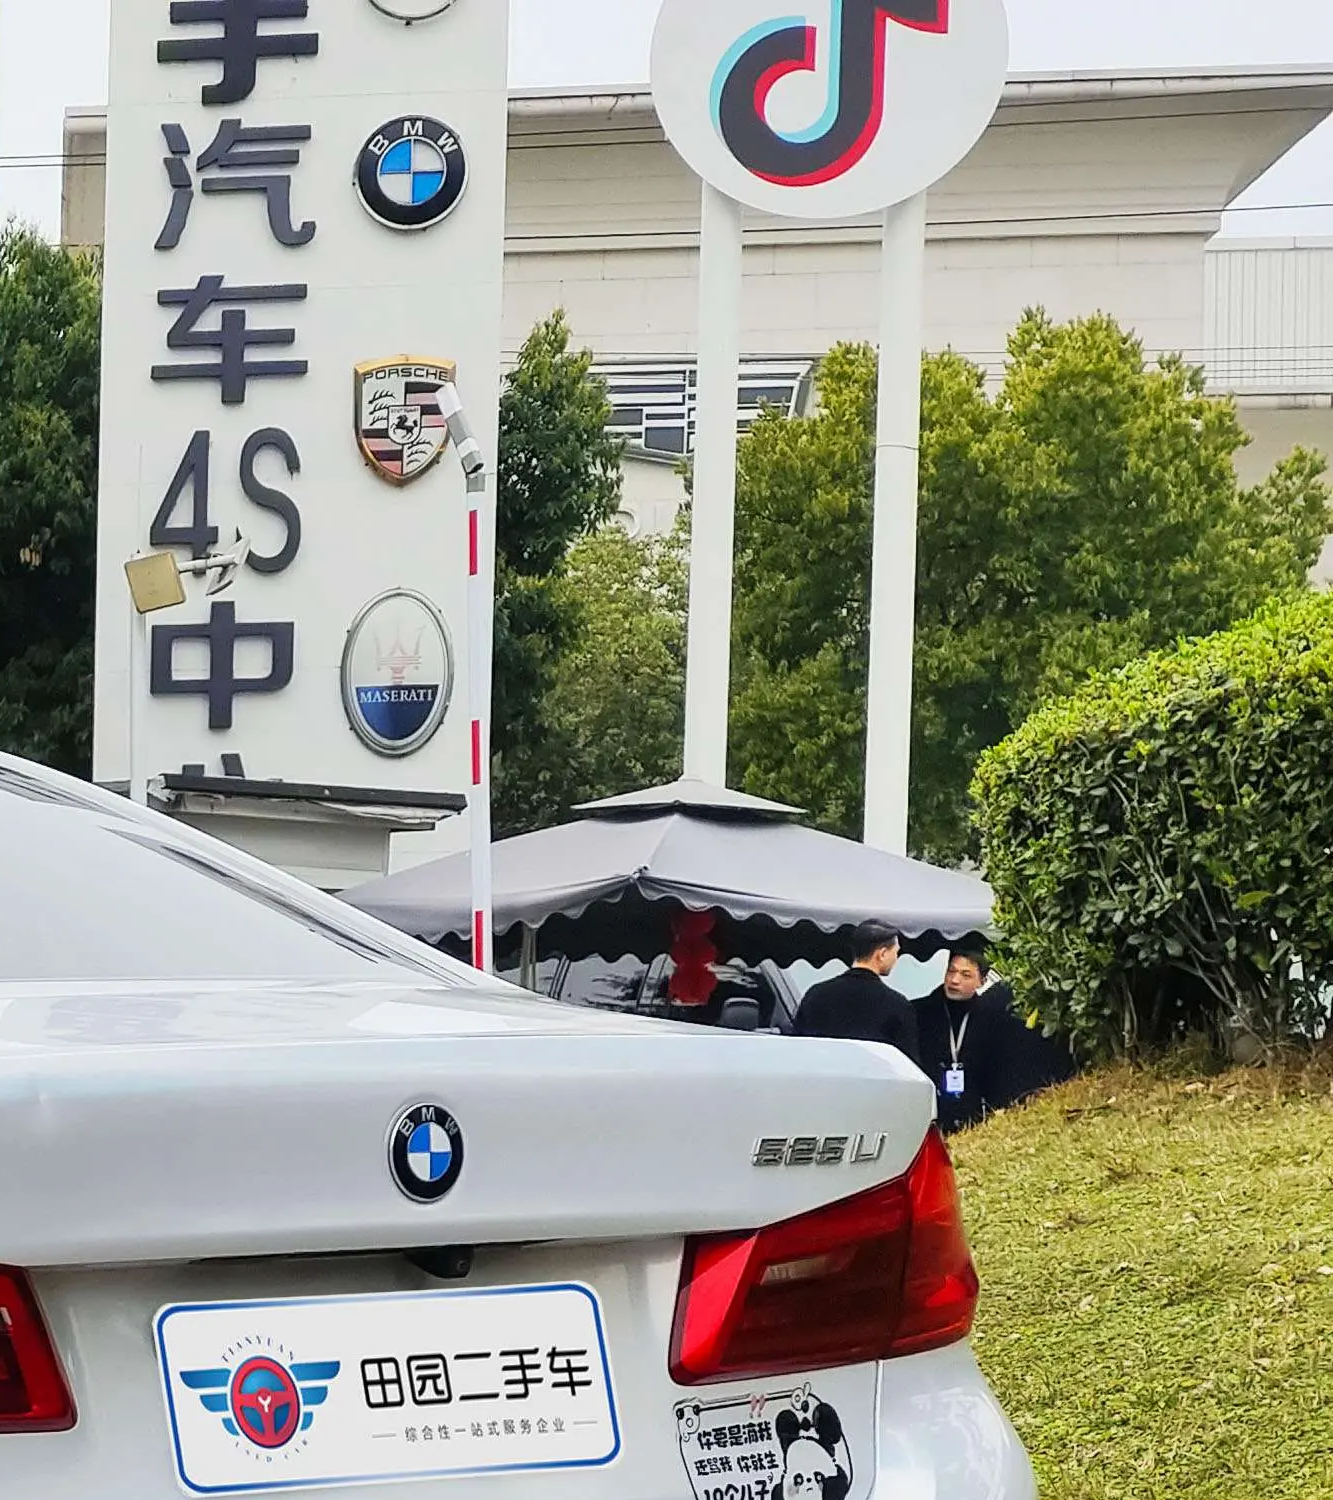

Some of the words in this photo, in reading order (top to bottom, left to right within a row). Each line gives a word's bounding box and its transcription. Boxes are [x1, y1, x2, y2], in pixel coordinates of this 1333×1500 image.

[368, 120, 459, 156] BMW
[150, 0, 319, 777] 手汽车4S中
[363, 367, 449, 383] PORSCHE
[360, 689, 433, 703] MASERATI
[399, 1106, 458, 1138] BMW
[360, 1347, 593, 1409] 田园二手车
[404, 1417, 566, 1443] 综合性一站式服务企业
